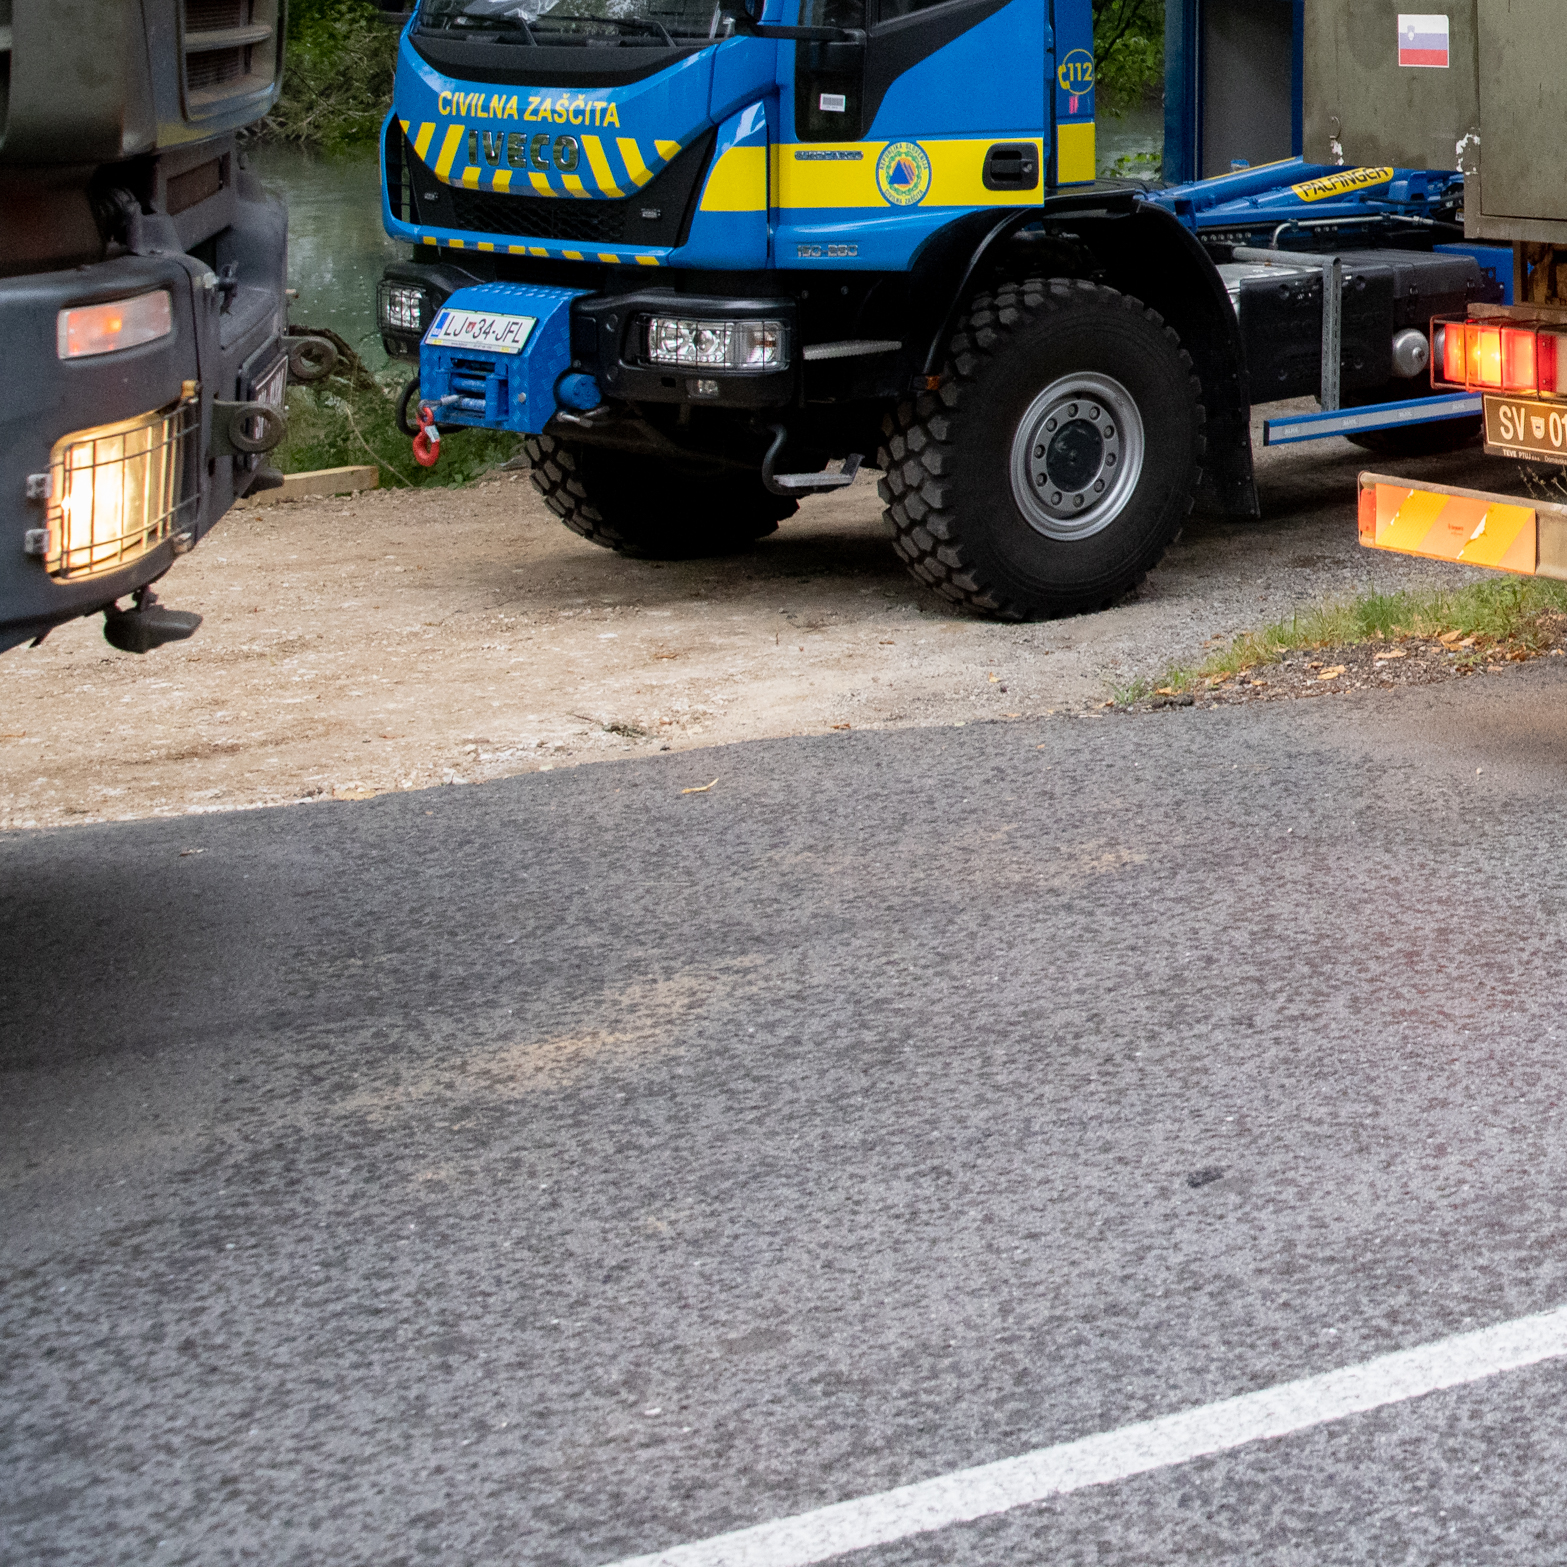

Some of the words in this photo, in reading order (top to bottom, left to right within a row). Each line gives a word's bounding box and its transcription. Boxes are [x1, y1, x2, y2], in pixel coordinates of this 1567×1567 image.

[1067, 62, 1093, 82] 112
[438, 91, 519, 120] CIVILNA
[523, 93, 620, 128] ZAŠČITA
[468, 129, 581, 173] IVECO
[1298, 167, 1390, 198] PALFINGER
[444, 315, 469, 337] LJ
[472, 318, 523, 343] 34-JFL
[1499, 405, 1526, 441] SV
